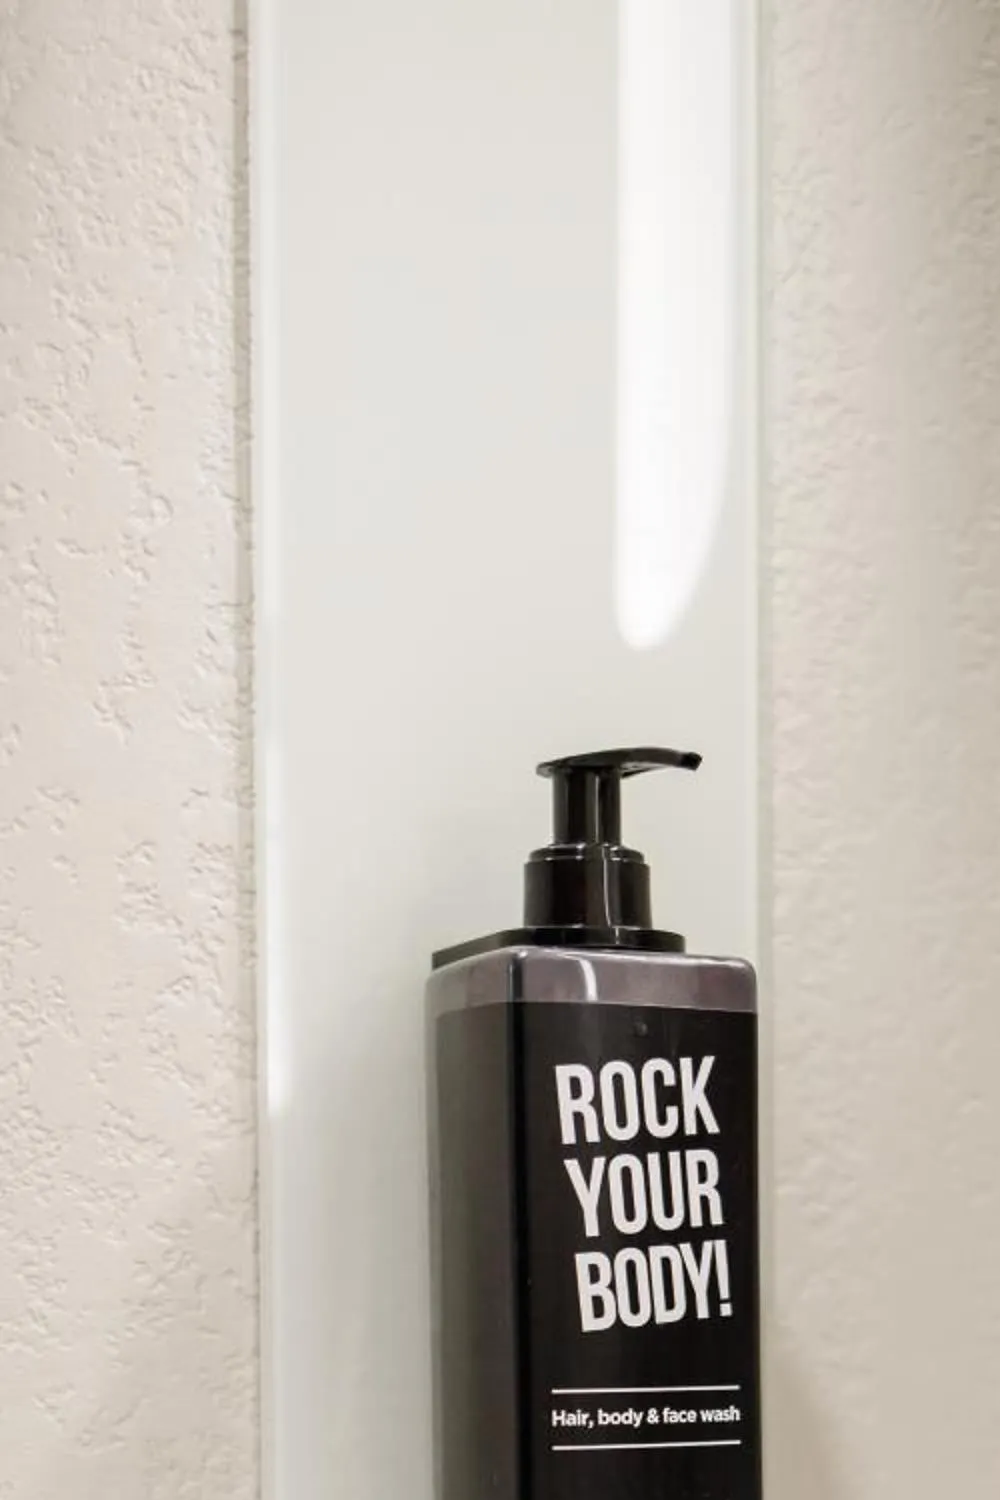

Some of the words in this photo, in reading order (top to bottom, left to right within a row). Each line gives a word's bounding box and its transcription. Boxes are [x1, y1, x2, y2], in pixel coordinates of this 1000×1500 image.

[554, 1055, 721, 1145] ROCK
[563, 1148, 724, 1238] YOUR
[574, 1239, 733, 1333] BODY!
[551, 1408, 595, 1429] Hair,
[597, 1407, 644, 1428] body
[646, 1407, 660, 1425] &
[661, 1407, 698, 1424] face
[699, 1405, 741, 1423] wash
